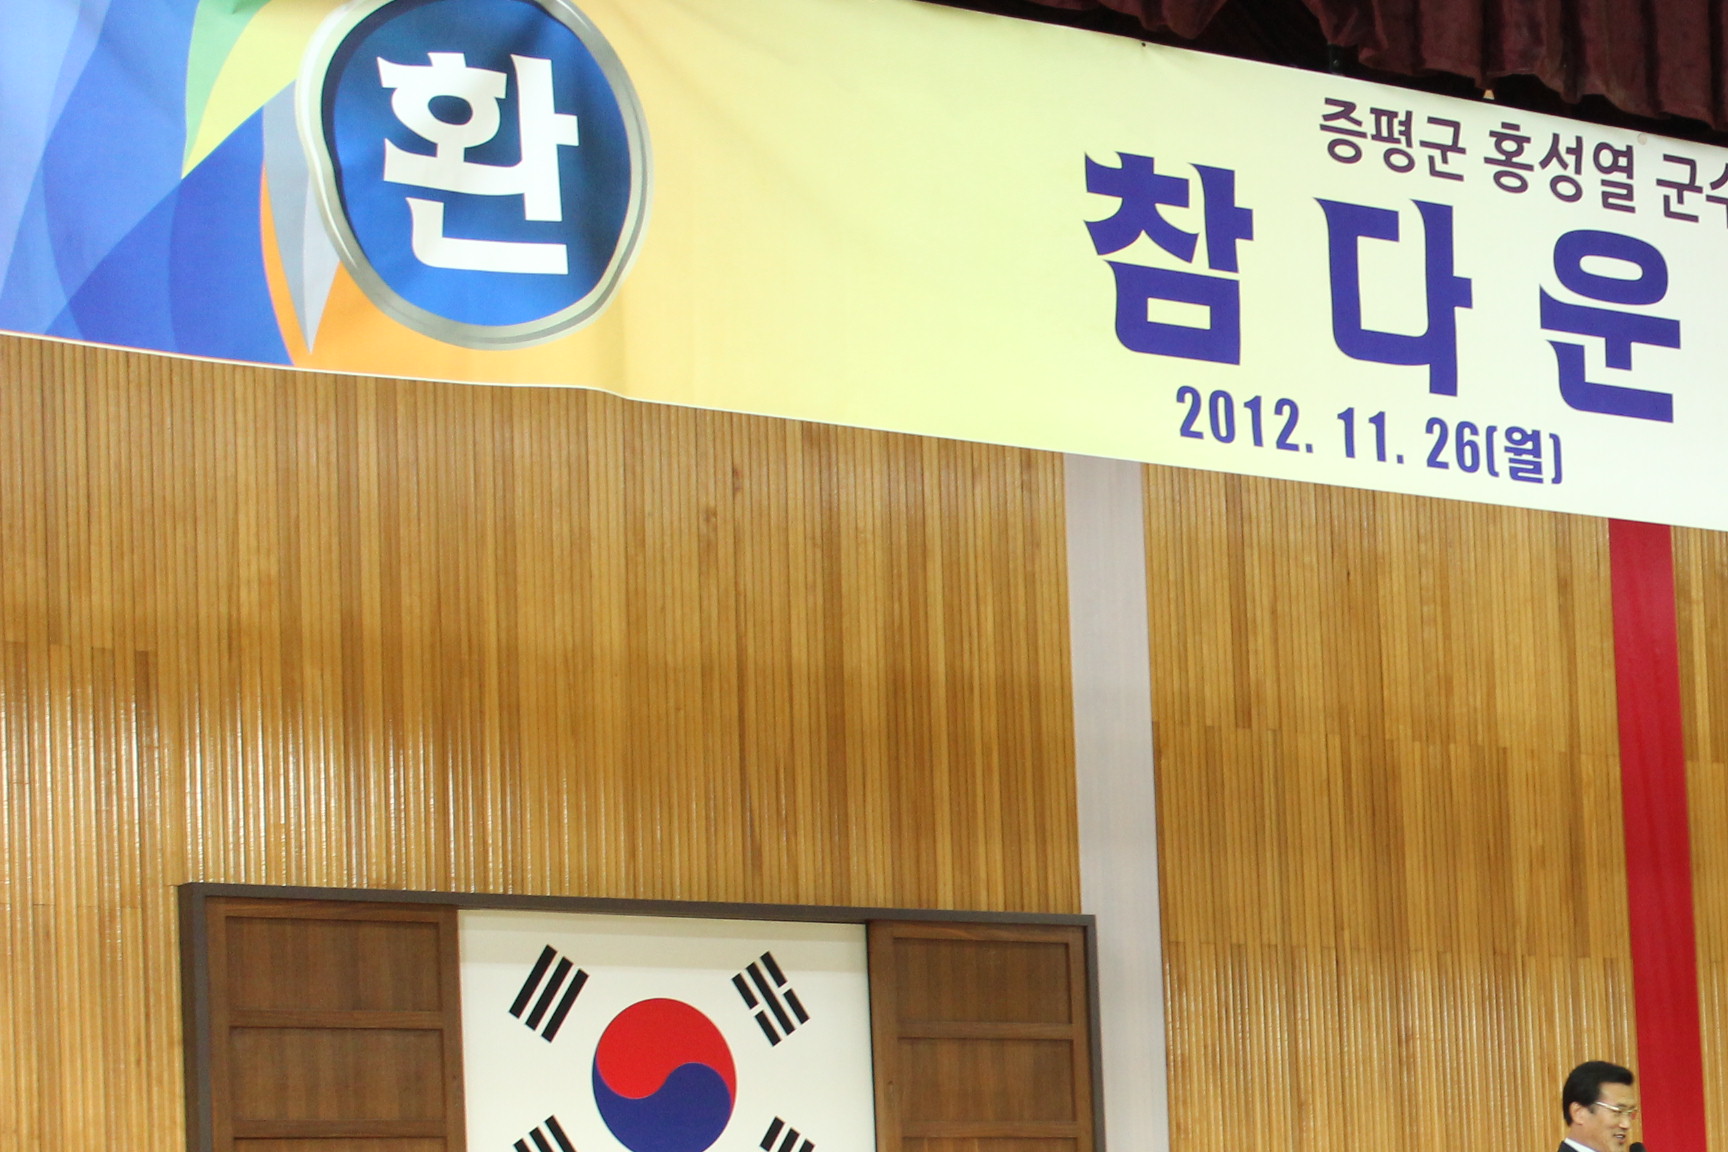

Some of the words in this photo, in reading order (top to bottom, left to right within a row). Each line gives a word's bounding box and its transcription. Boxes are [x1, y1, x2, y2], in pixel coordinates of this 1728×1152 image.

[377, 52, 580, 275] 환
[1319, 97, 1466, 182] 증평군
[1483, 122, 1637, 214] 홍성열
[1084, 150, 1682, 424] 참다운
[1176, 385, 1314, 454] 2012.
[1337, 406, 1404, 465] 11.
[1425, 417, 1563, 485] 26(월)
